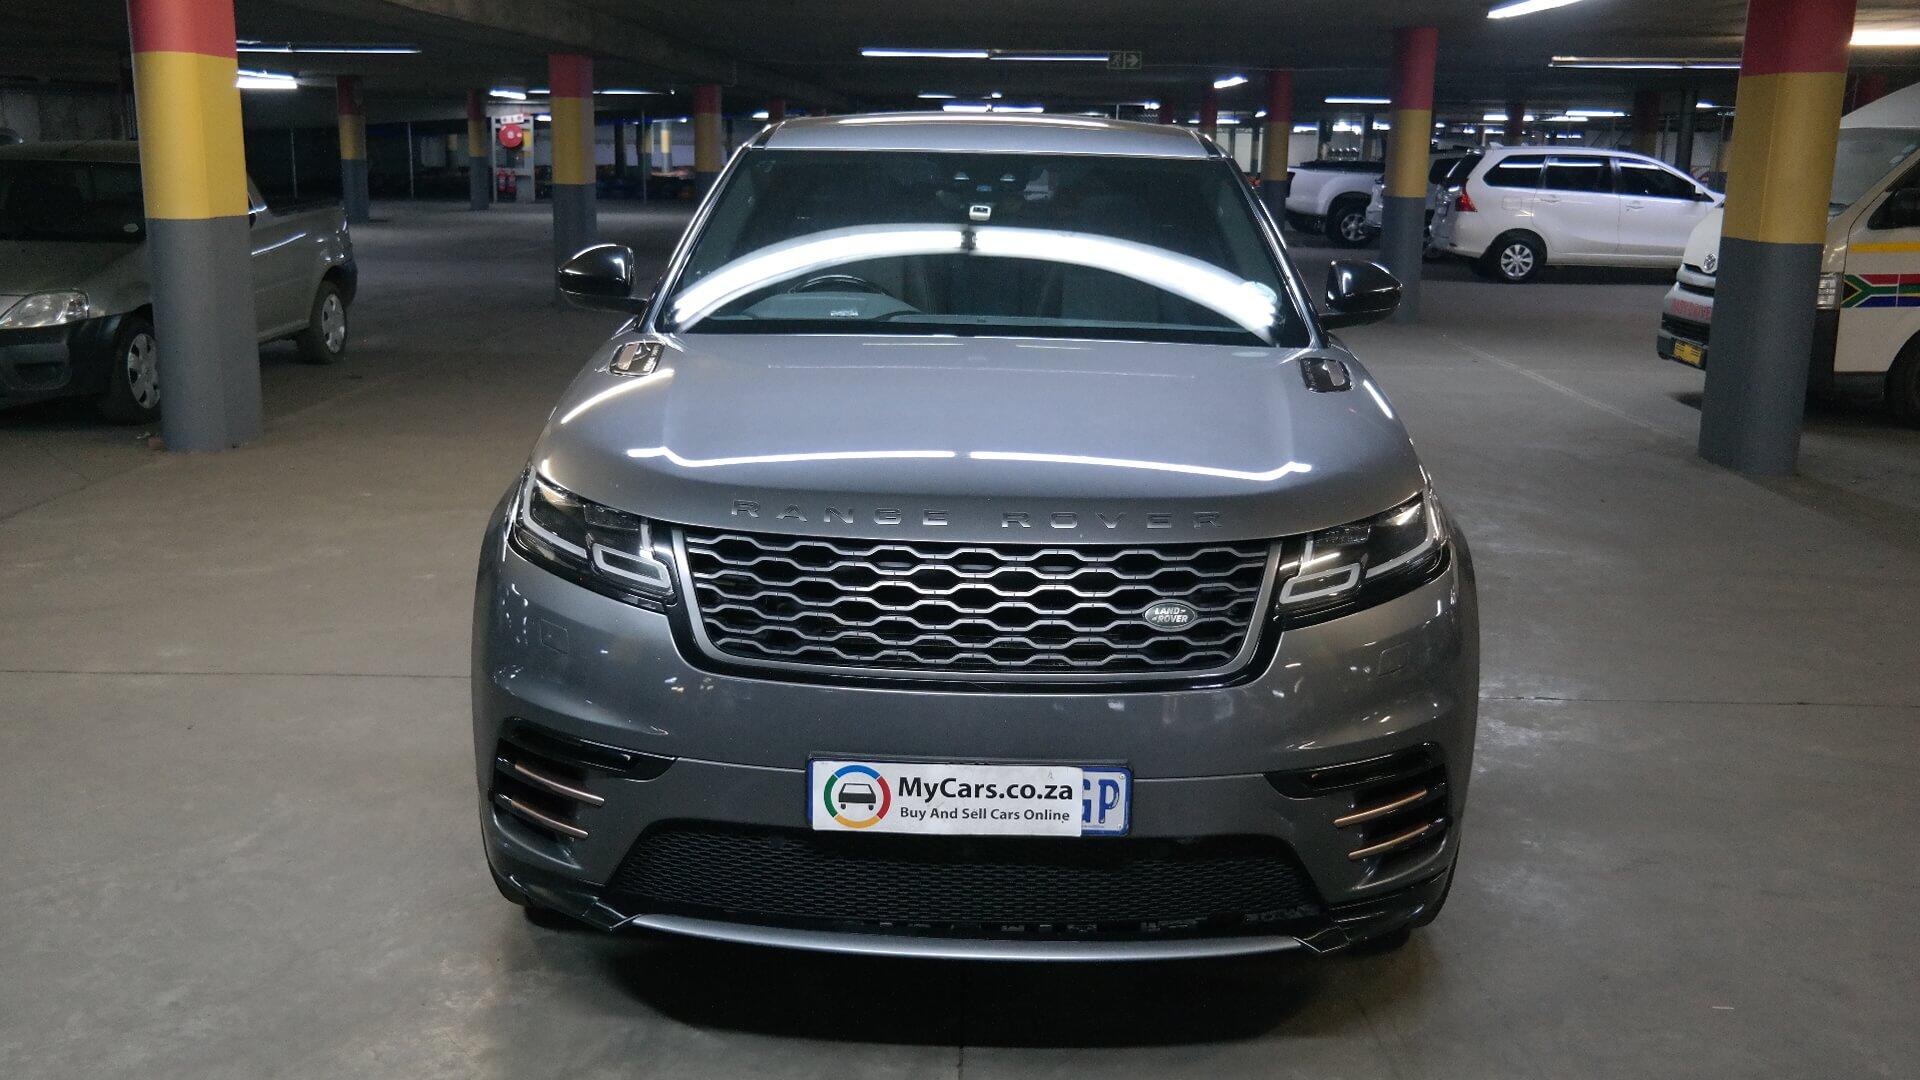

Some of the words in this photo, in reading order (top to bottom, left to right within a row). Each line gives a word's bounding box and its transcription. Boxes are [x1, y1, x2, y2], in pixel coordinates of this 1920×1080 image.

[731, 499, 948, 526] RANGE
[1001, 511, 1223, 529] ROVER
[898, 776, 1073, 803] MyCars.co.za
[900, 806, 927, 821] Buy
[930, 808, 958, 820] And
[962, 807, 987, 820] Sell
[990, 808, 1020, 820] Cars
[1023, 808, 1070, 821] Online
